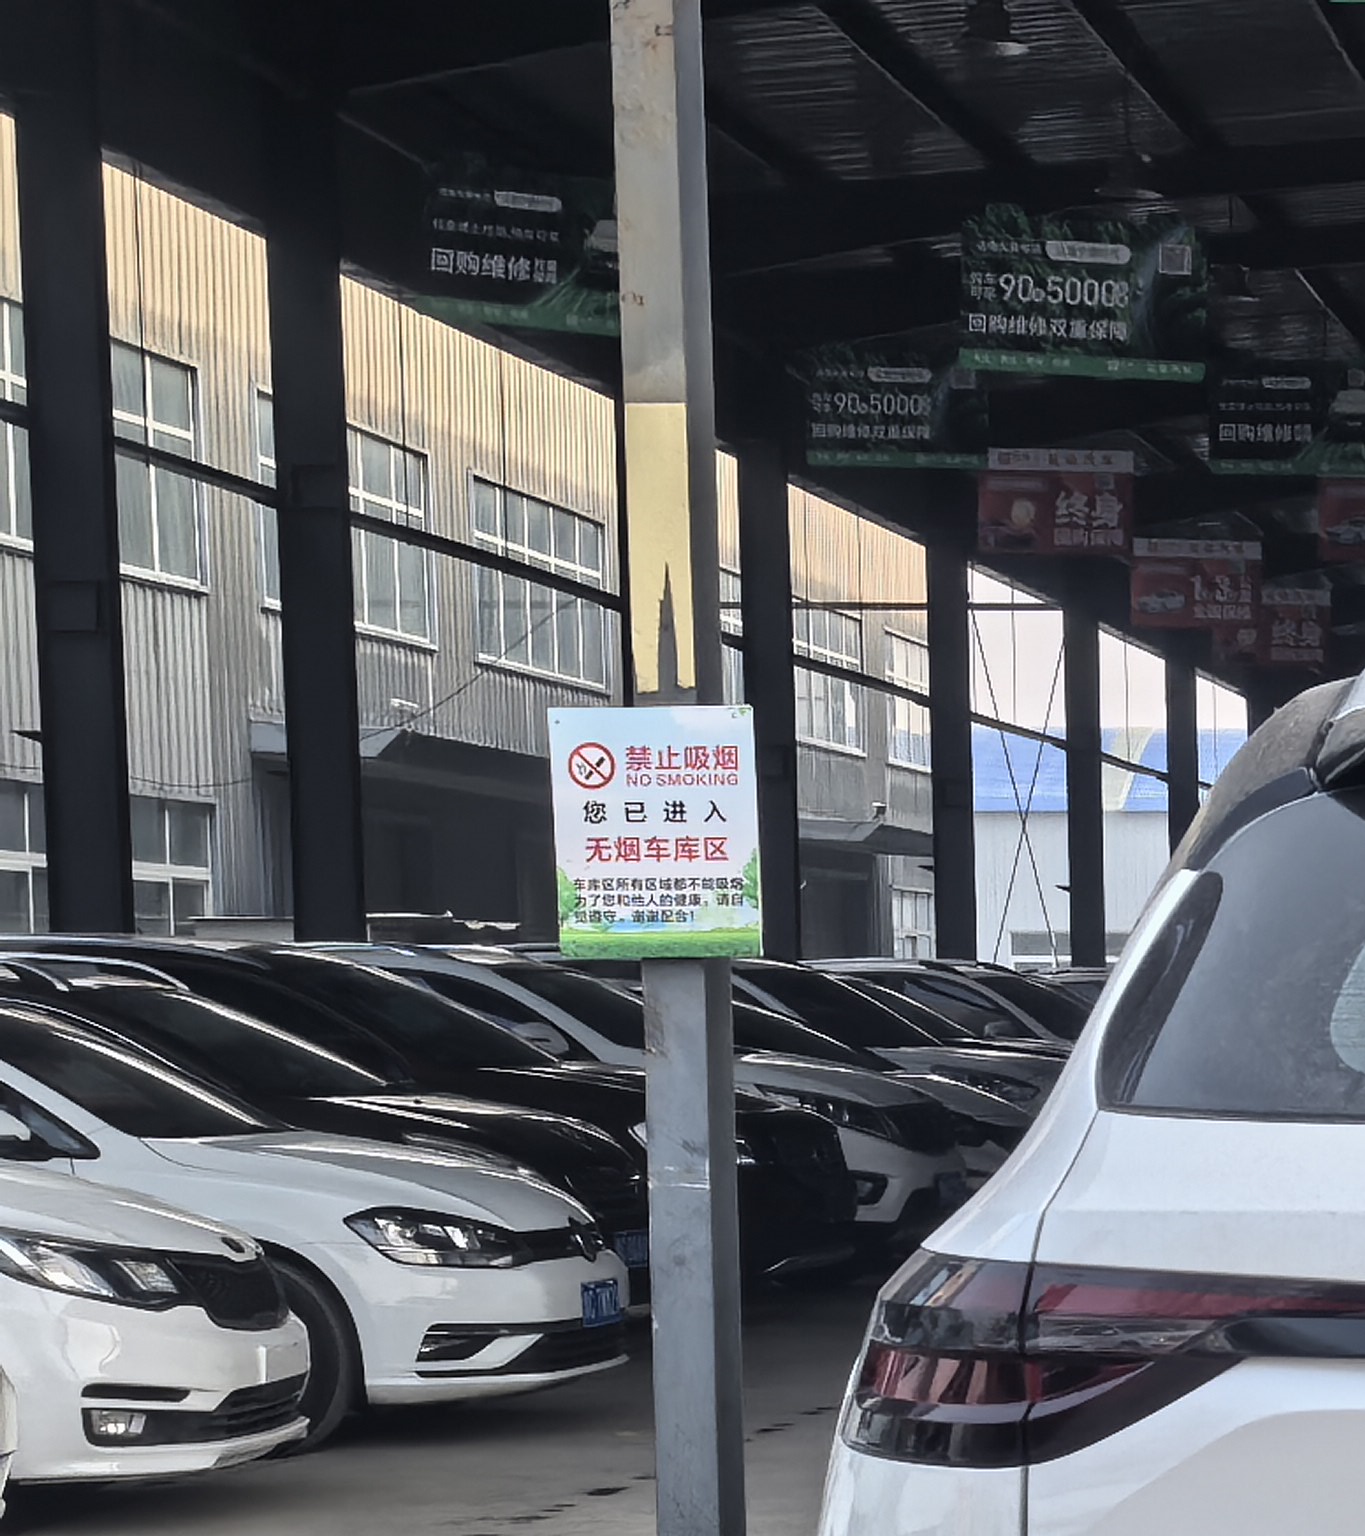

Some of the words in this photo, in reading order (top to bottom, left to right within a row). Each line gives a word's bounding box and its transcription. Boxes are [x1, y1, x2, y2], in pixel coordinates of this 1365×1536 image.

[626, 745, 738, 771] 禁止吸烟
[626, 774, 652, 787] NO
[656, 774, 738, 786] SMOKING
[583, 800, 727, 824] 您已进入
[585, 836, 729, 863] 无烟车库区
